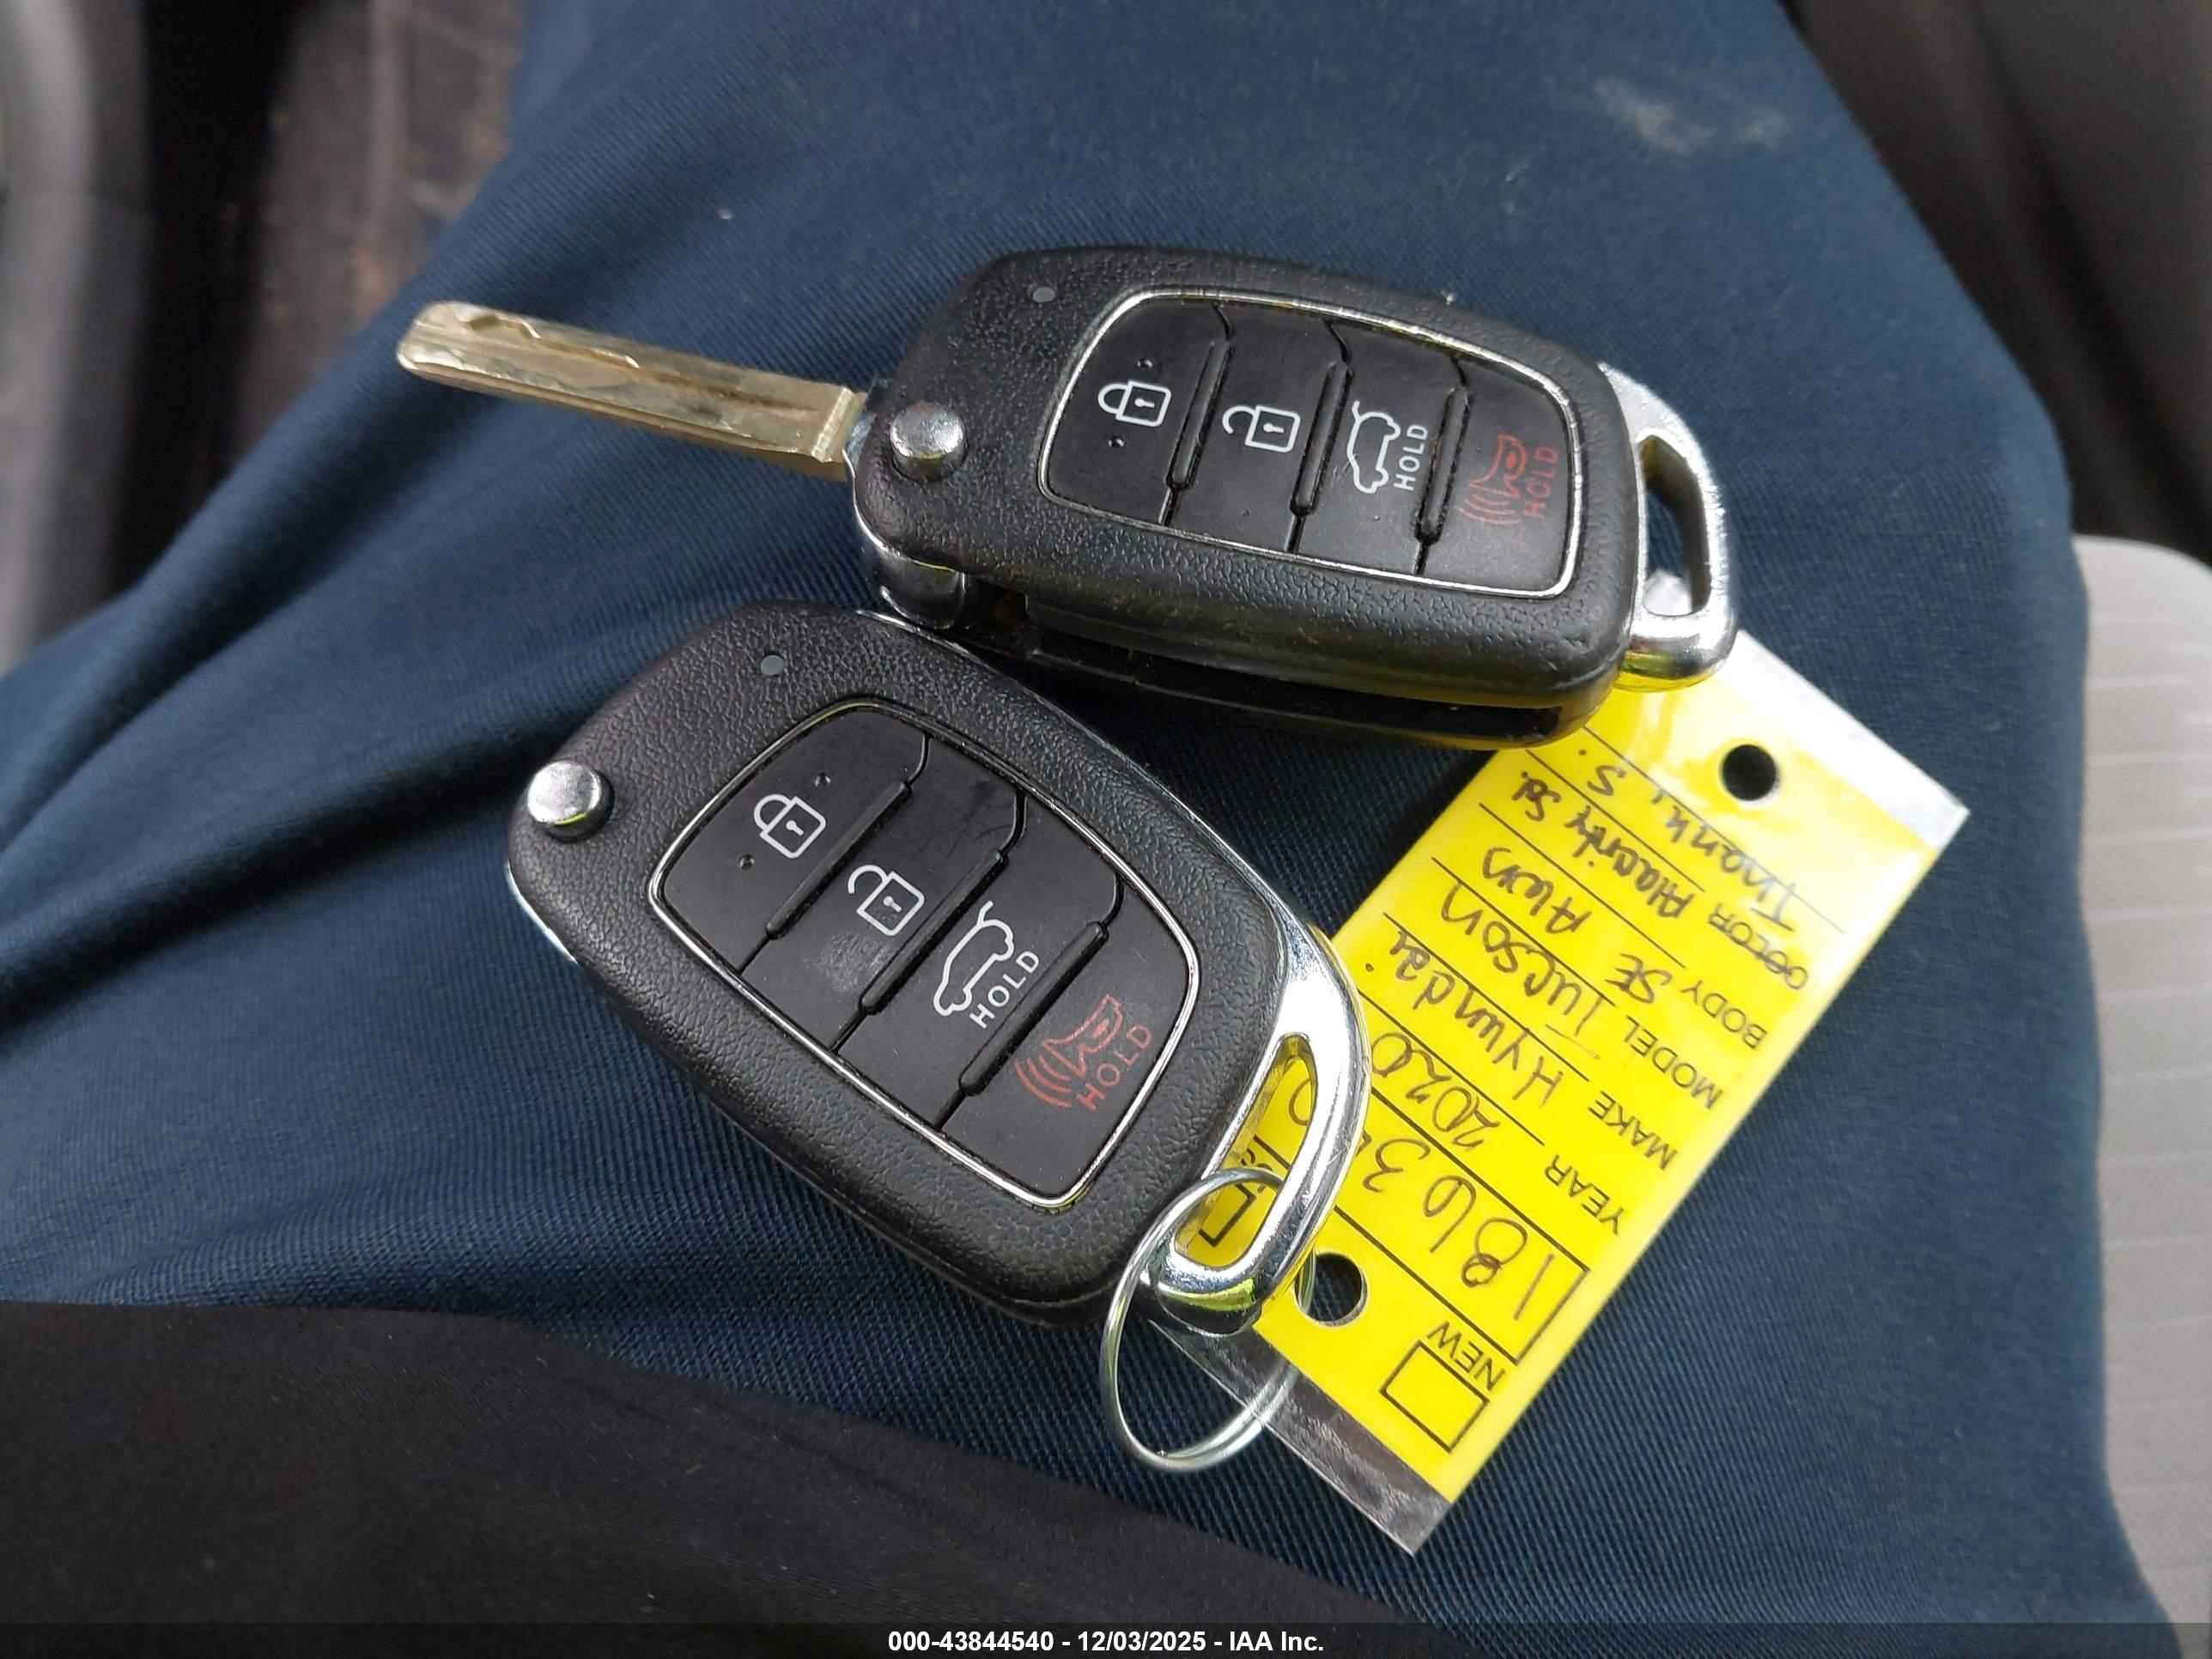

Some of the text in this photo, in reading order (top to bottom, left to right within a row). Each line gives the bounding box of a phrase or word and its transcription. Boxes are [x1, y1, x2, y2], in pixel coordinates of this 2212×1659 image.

[1393, 423, 1428, 491] HOLD
[1523, 445, 1559, 520] HOLD
[969, 951, 1040, 1029] HOLD
[1440, 882, 1605, 1060] Tucson
[1604, 952, 1673, 1004] SE
[1364, 930, 1564, 1107] Hyundai
[1681, 979, 1768, 1050] BODY
[1076, 1024, 1152, 1112] HOLD
[1371, 1031, 1501, 1150] 2020
[1622, 1015, 1724, 1109] MODEL
[1587, 1091, 1679, 1171] MAKE
[1543, 1154, 1627, 1236] YEAR
[1426, 1320, 1505, 1391] NEW
